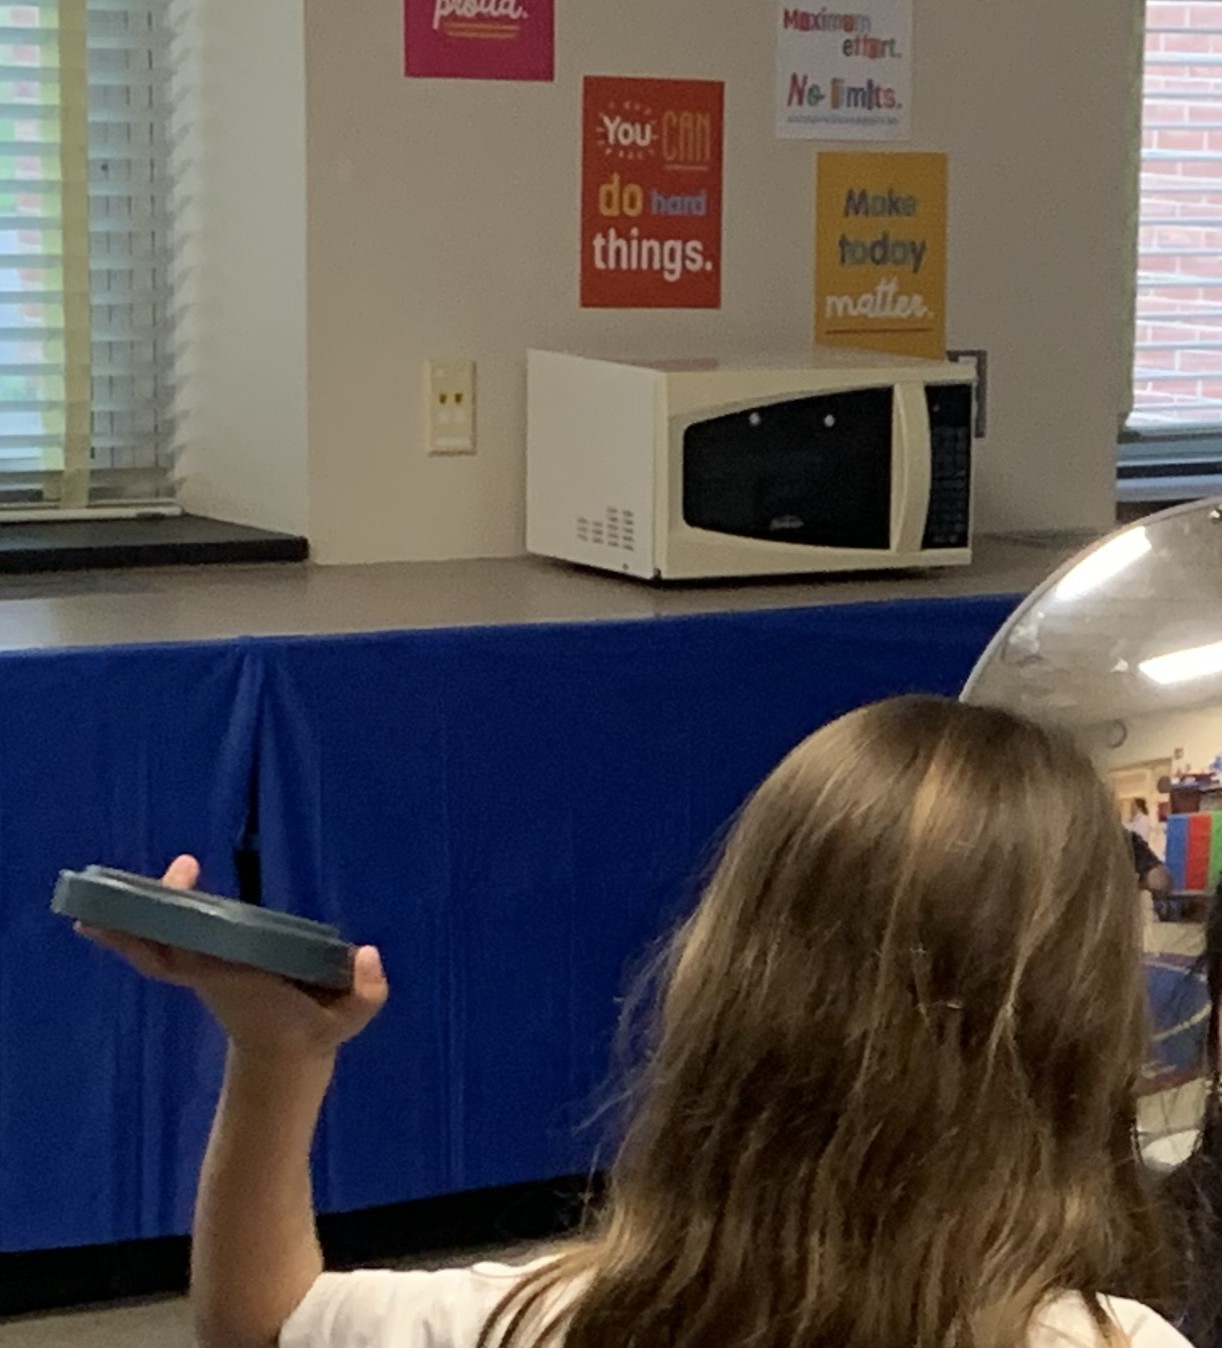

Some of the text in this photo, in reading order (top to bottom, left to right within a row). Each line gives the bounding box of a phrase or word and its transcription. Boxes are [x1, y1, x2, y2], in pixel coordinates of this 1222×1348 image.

[783, 6, 871, 32] Maximum
[842, 34, 903, 59] effort.
[786, 72, 903, 111] No limits.
[603, 110, 711, 162] You CAN
[600, 171, 707, 217] do hard
[844, 187, 918, 218] Make
[593, 226, 713, 282] things.
[838, 230, 927, 274] today
[825, 276, 935, 320] matter.
